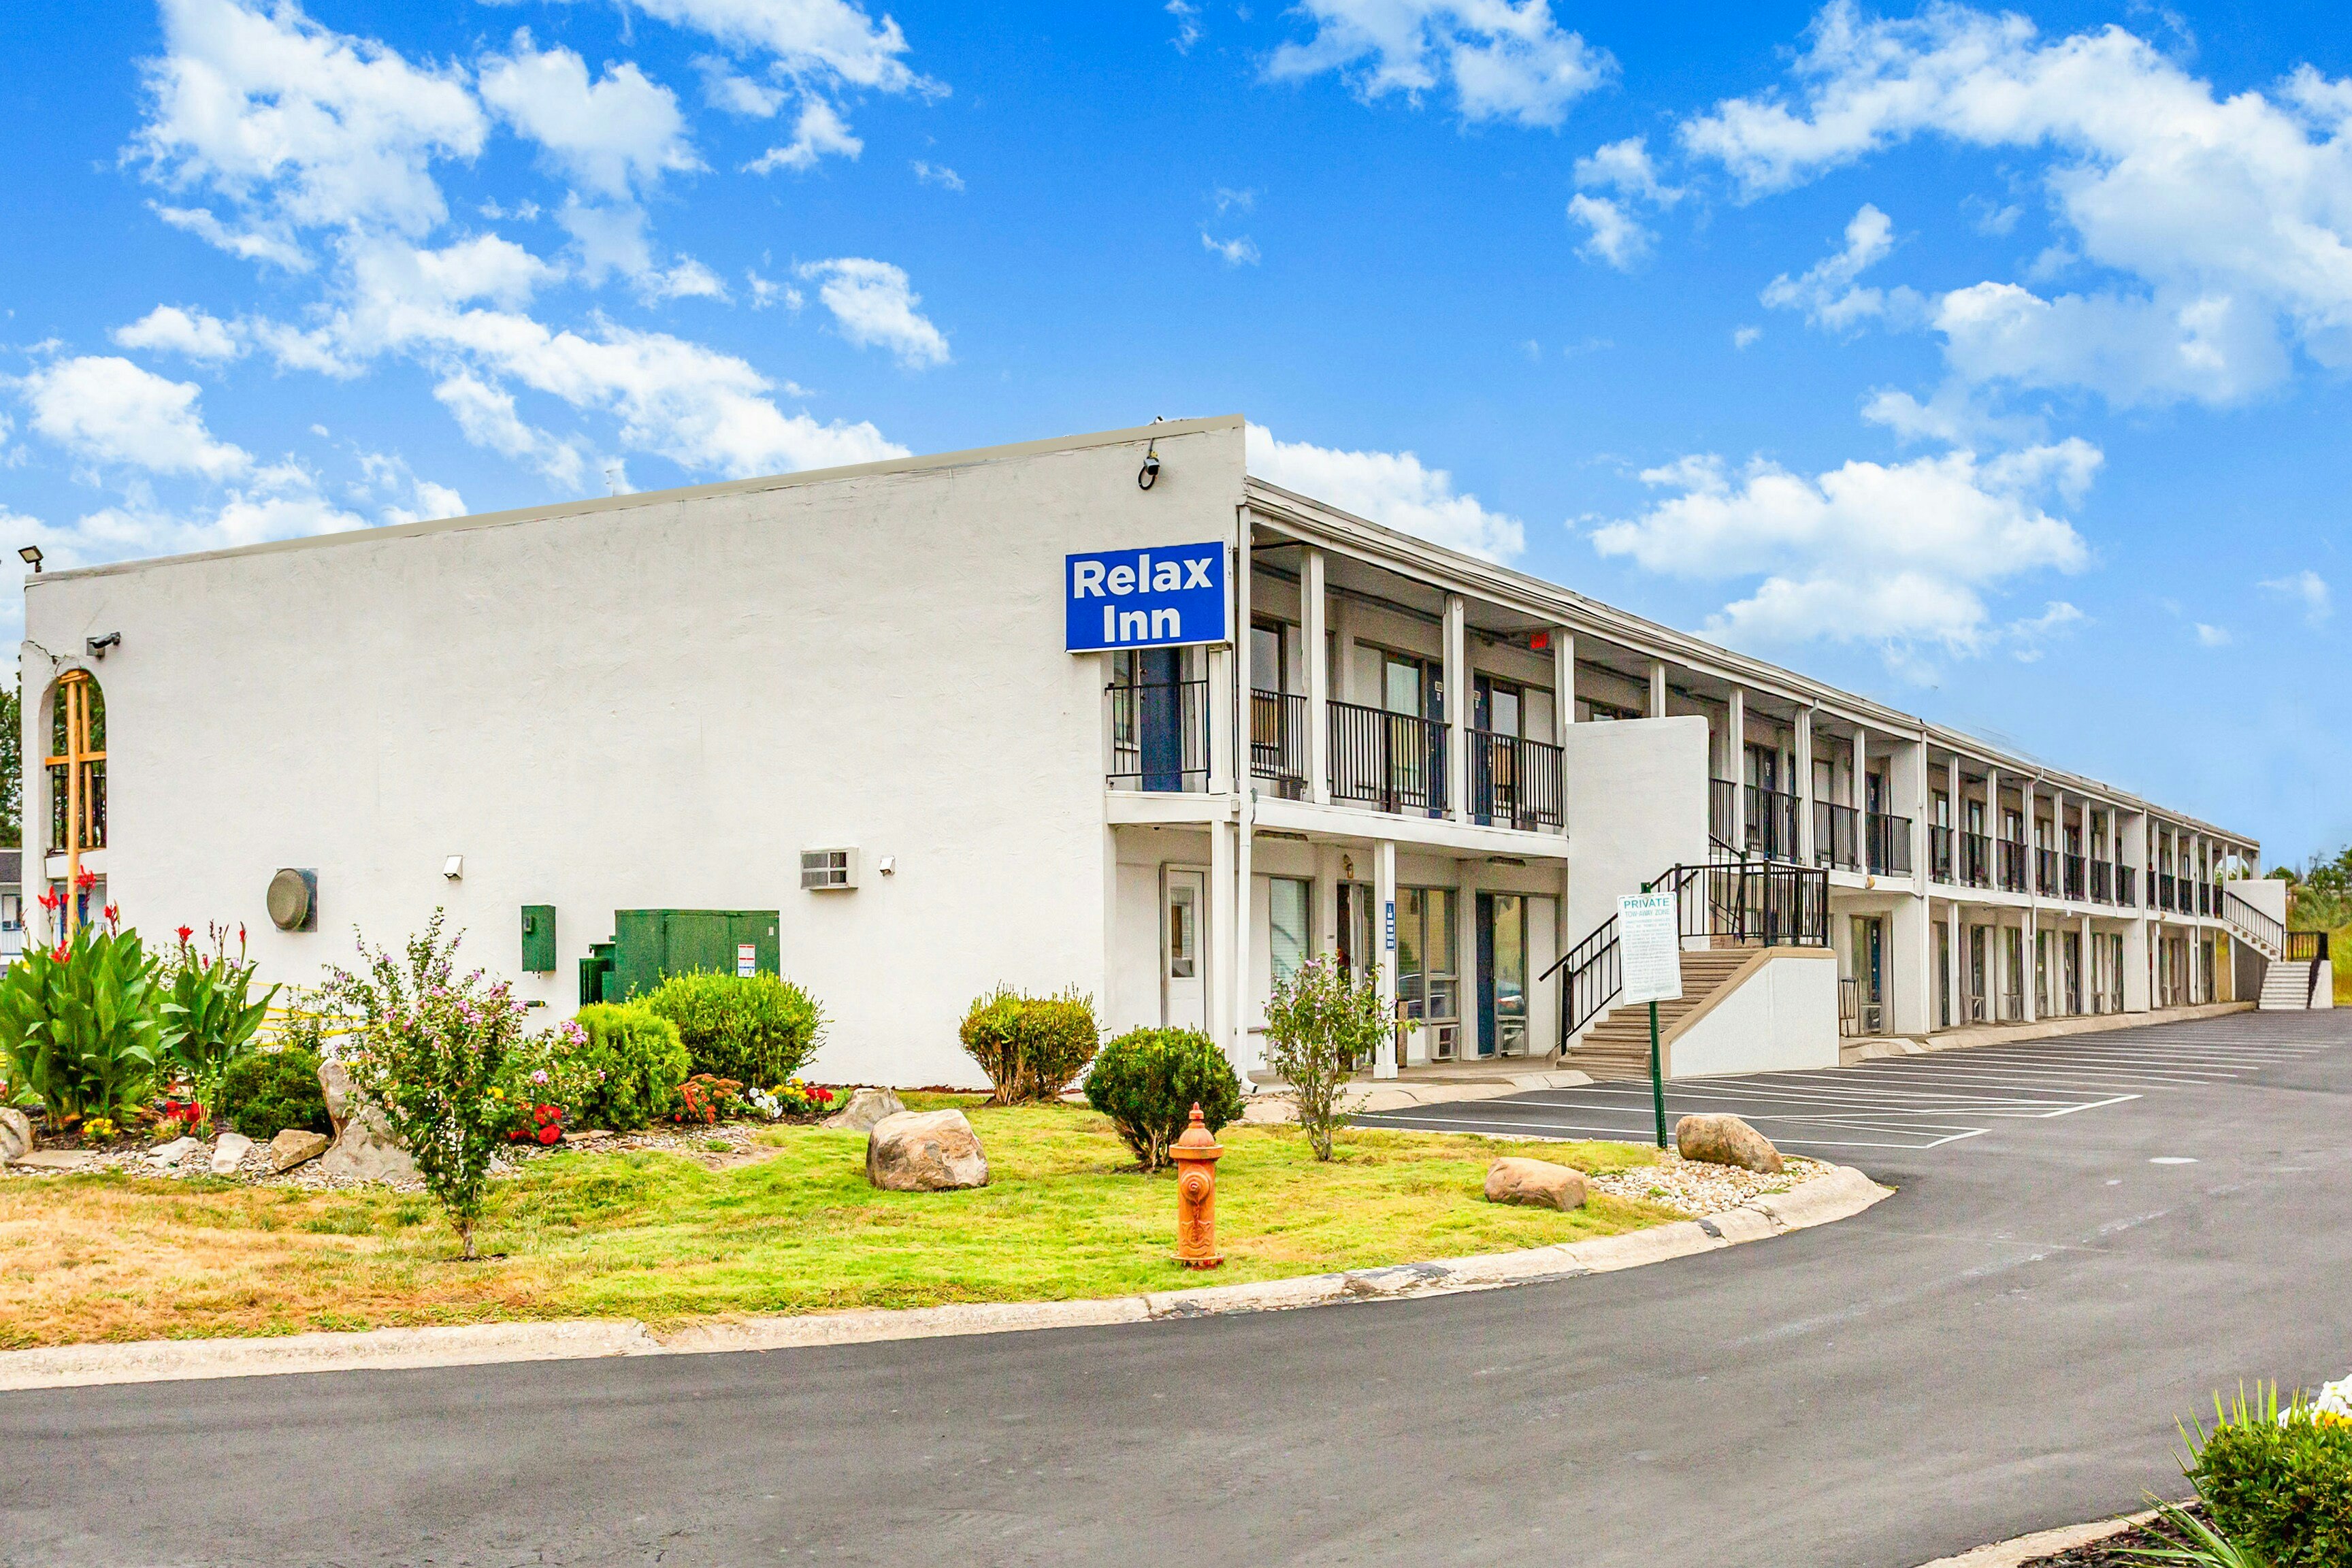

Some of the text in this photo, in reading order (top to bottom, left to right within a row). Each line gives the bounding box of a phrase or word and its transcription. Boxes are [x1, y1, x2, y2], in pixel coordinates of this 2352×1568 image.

[1074, 553, 1213, 599] Relax
[1103, 604, 1181, 643] Inn
[1624, 897, 1670, 909] PRIVATE
